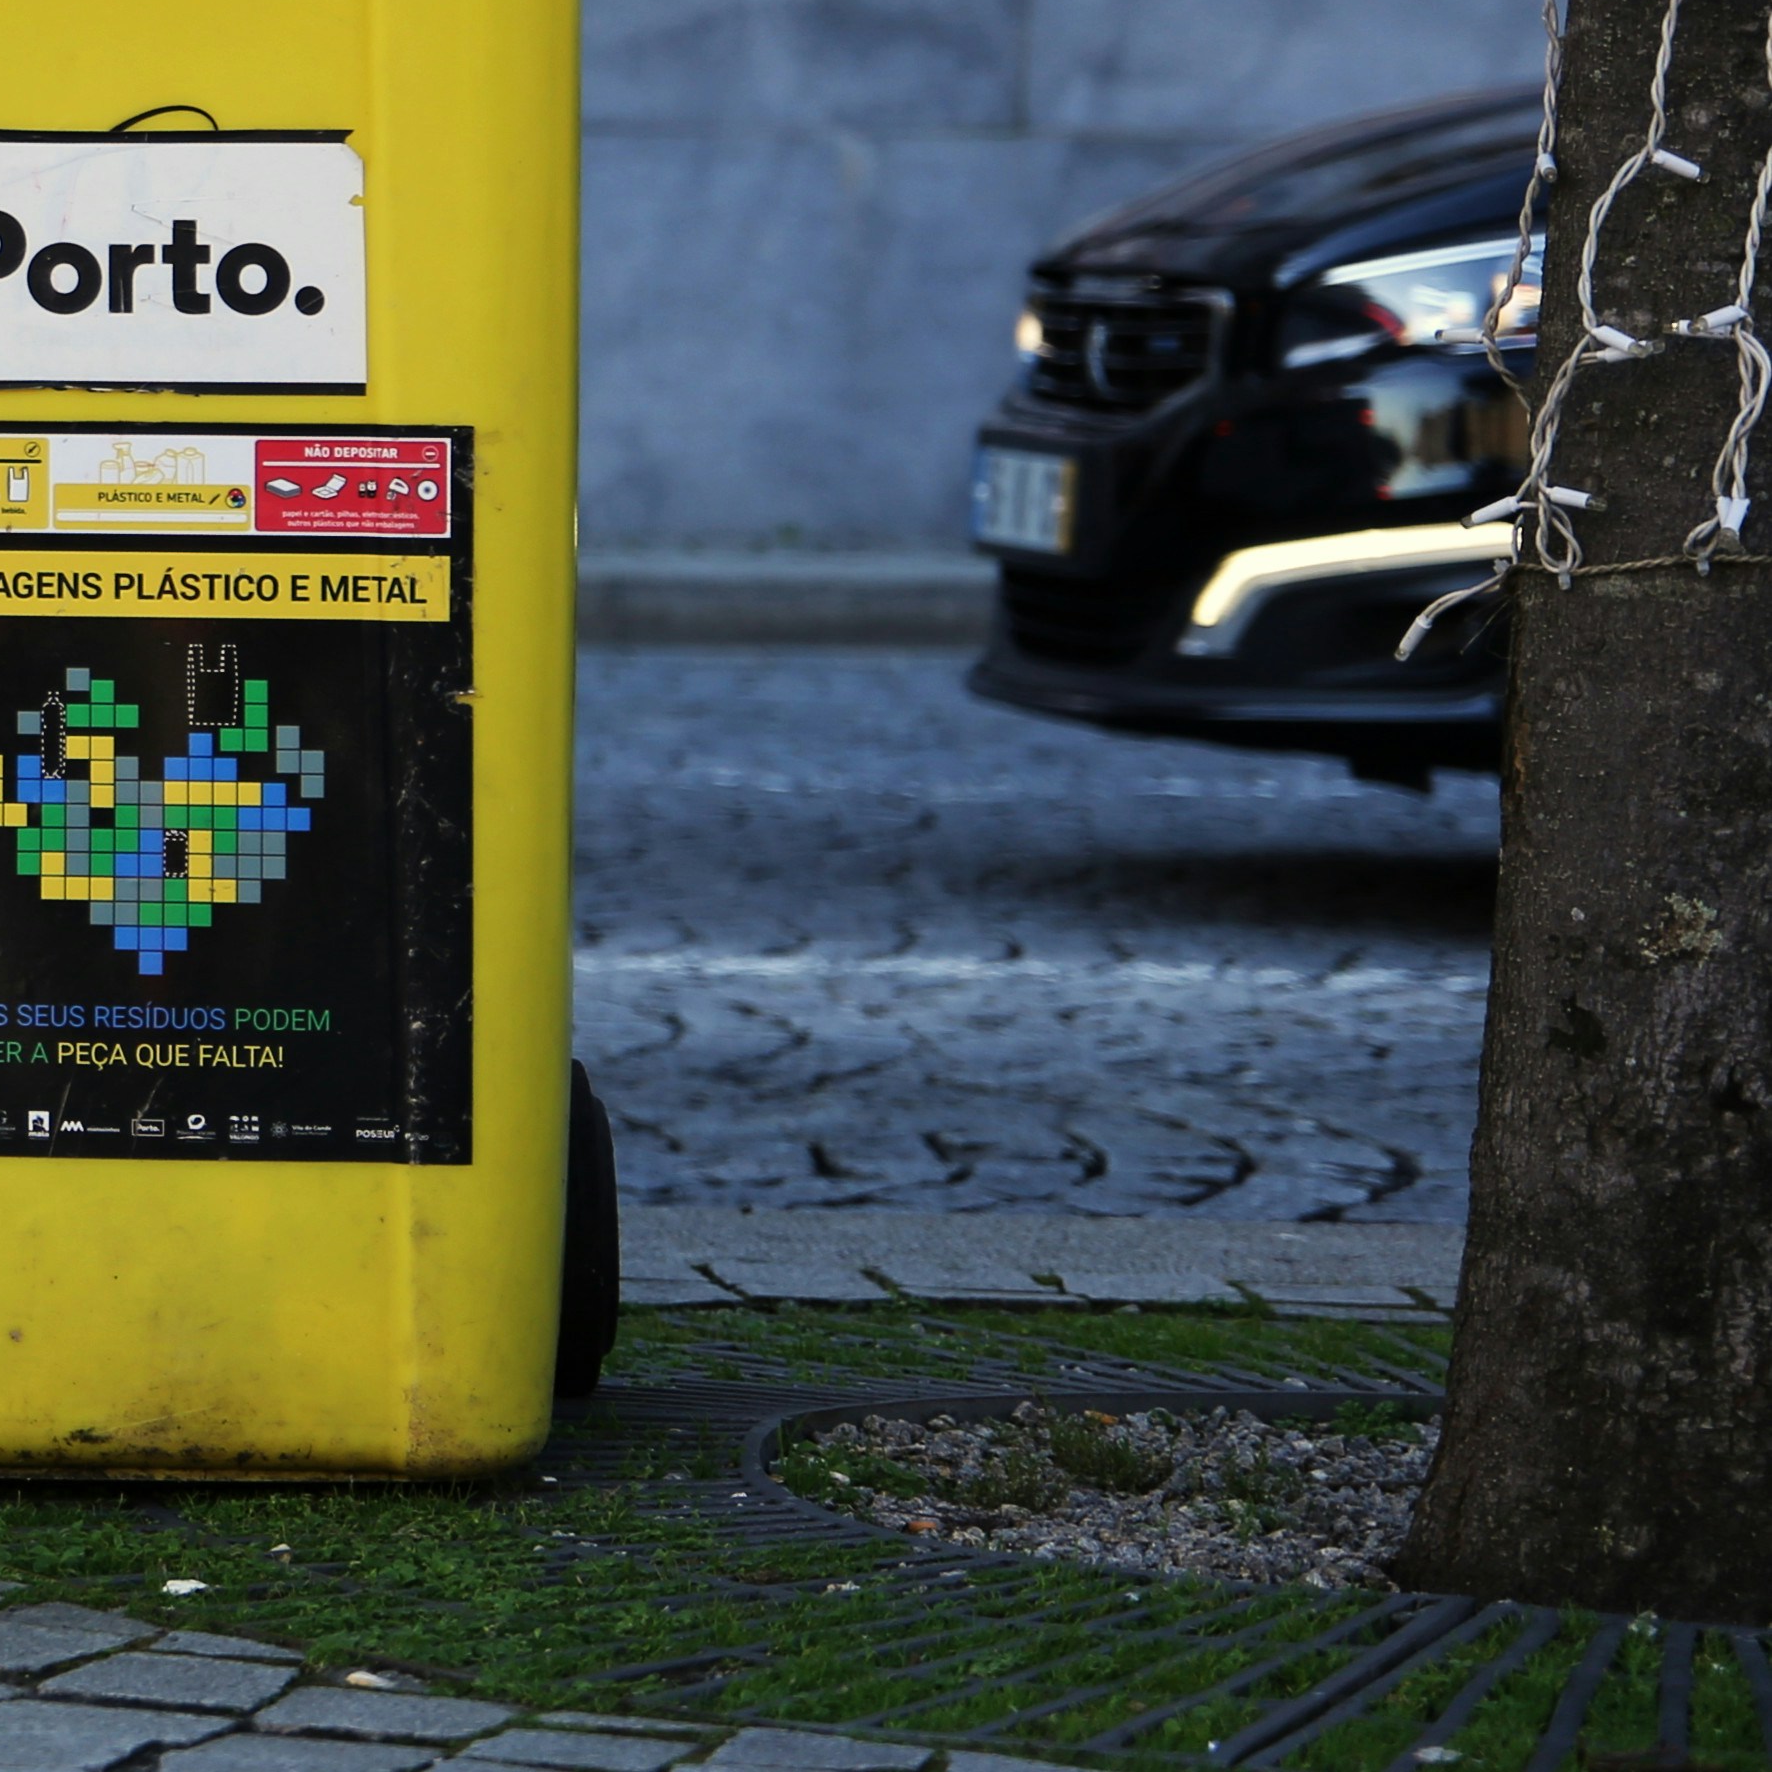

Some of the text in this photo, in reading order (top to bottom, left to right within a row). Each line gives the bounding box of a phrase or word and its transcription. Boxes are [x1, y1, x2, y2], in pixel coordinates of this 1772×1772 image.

[304, 443, 398, 459] NÃO DEPOSITAR
[98, 489, 205, 504] PLÁSTICO E METAL
[114, 567, 279, 602] PLÁSTICO
[290, 575, 310, 602] E
[320, 575, 428, 604] METAL
[16, 1004, 85, 1027] SEUS
[94, 1001, 226, 1030] RESÍDUOS
[235, 1008, 330, 1031] PODEM
[30, 1042, 49, 1064] A
[58, 1042, 127, 1071] PEÇA
[135, 1043, 190, 1068] QUE
[199, 1044, 284, 1068] FALTA!
